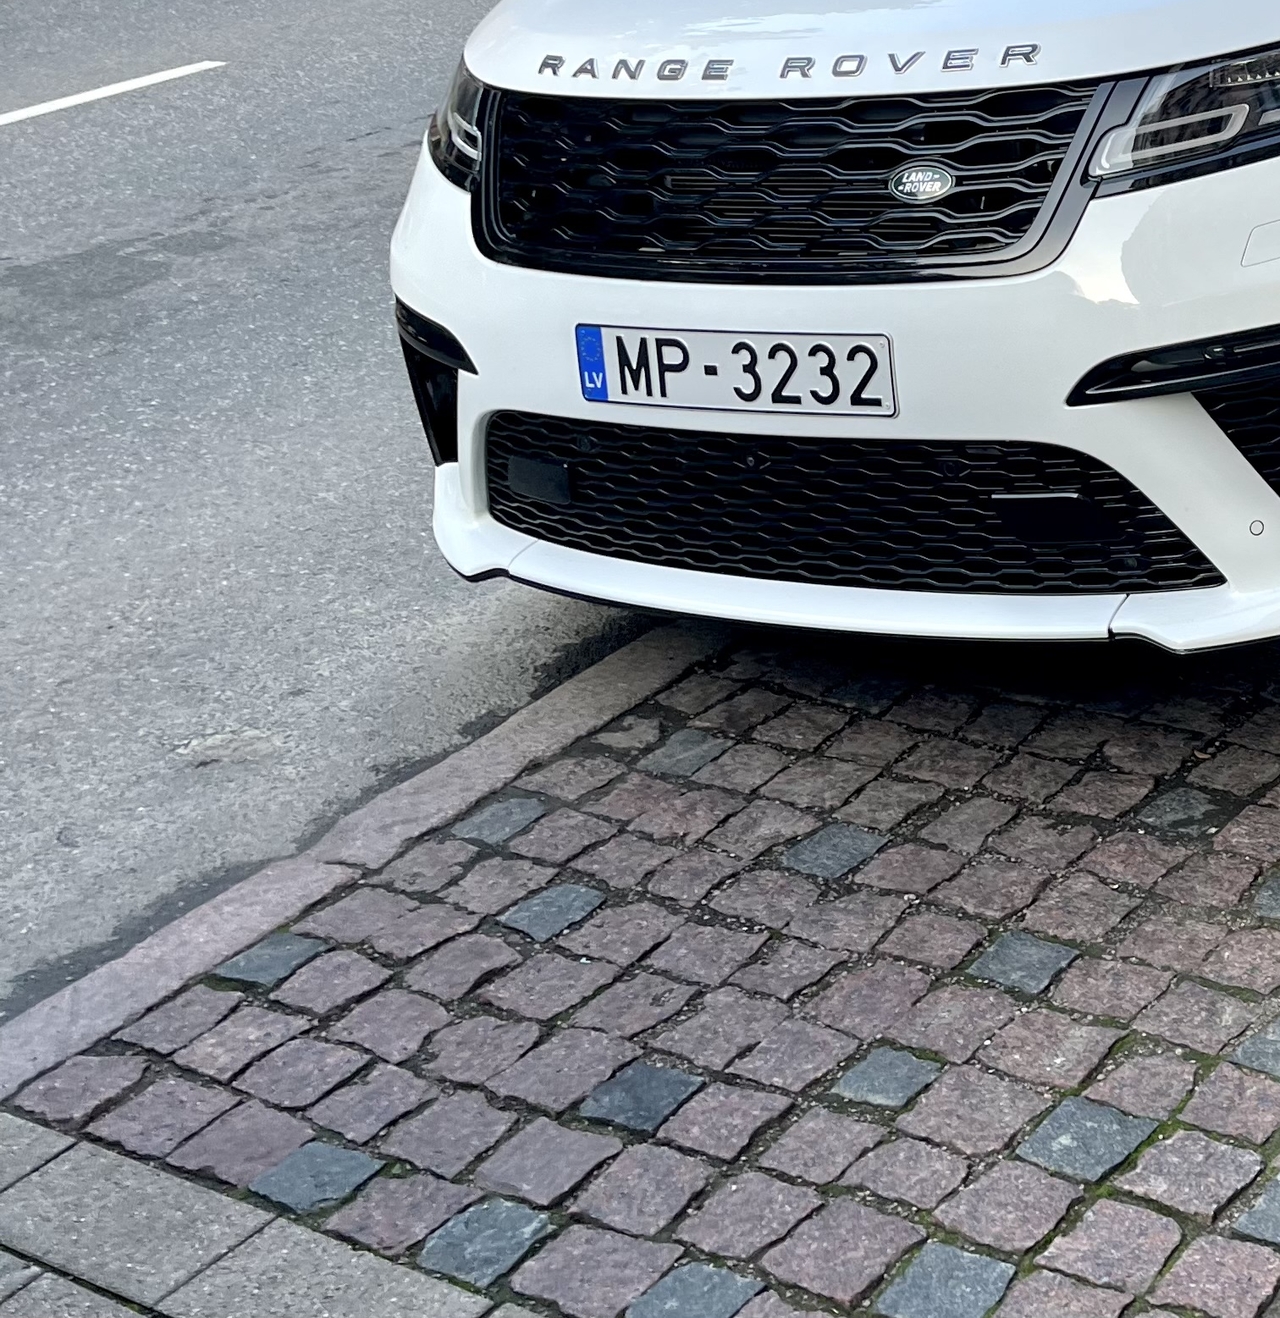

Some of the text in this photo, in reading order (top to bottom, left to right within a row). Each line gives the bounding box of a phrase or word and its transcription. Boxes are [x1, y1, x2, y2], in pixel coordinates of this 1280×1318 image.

[537, 43, 1042, 81] RANGE ROVER
[902, 171, 933, 183] LAND
[903, 181, 942, 193] ROVER
[584, 370, 604, 389] LV
[615, 335, 883, 407] MP-3232
